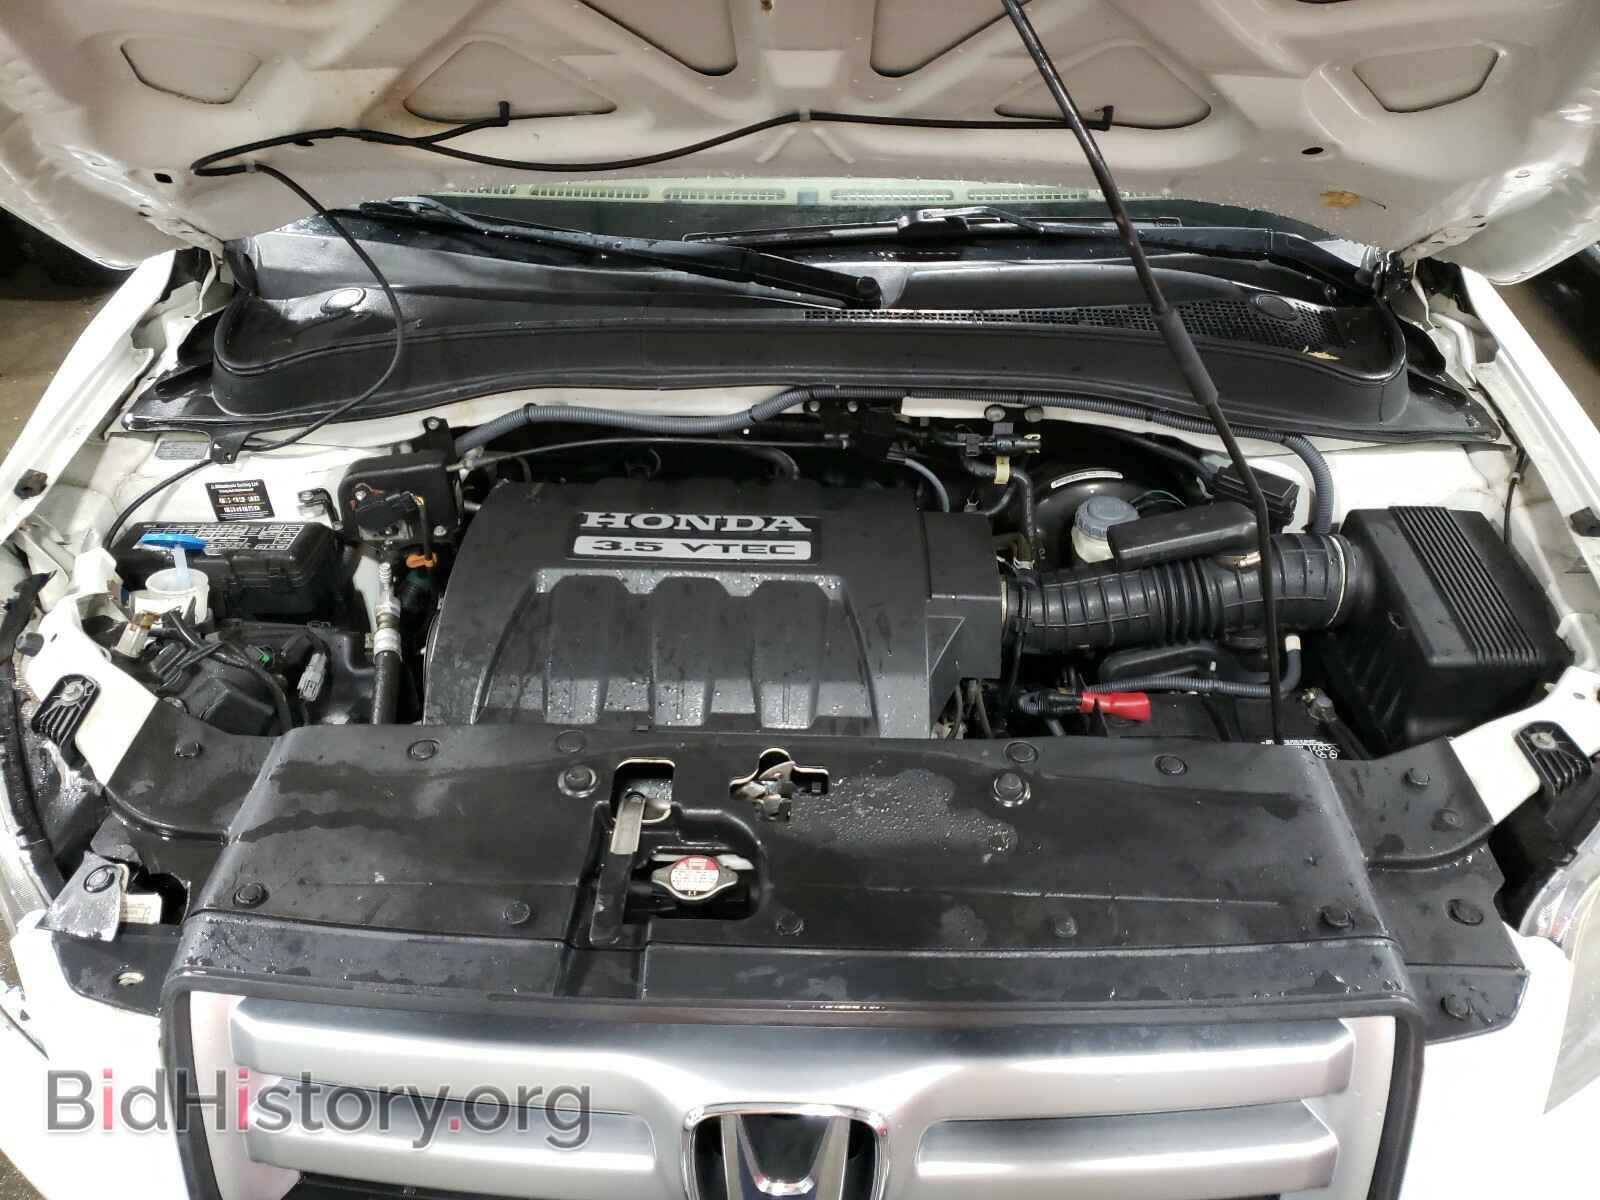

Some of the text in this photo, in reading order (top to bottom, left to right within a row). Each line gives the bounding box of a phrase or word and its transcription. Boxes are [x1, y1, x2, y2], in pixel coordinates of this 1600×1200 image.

[580, 511, 812, 533] HONDA
[592, 540, 796, 555] 3.5 VTEC
